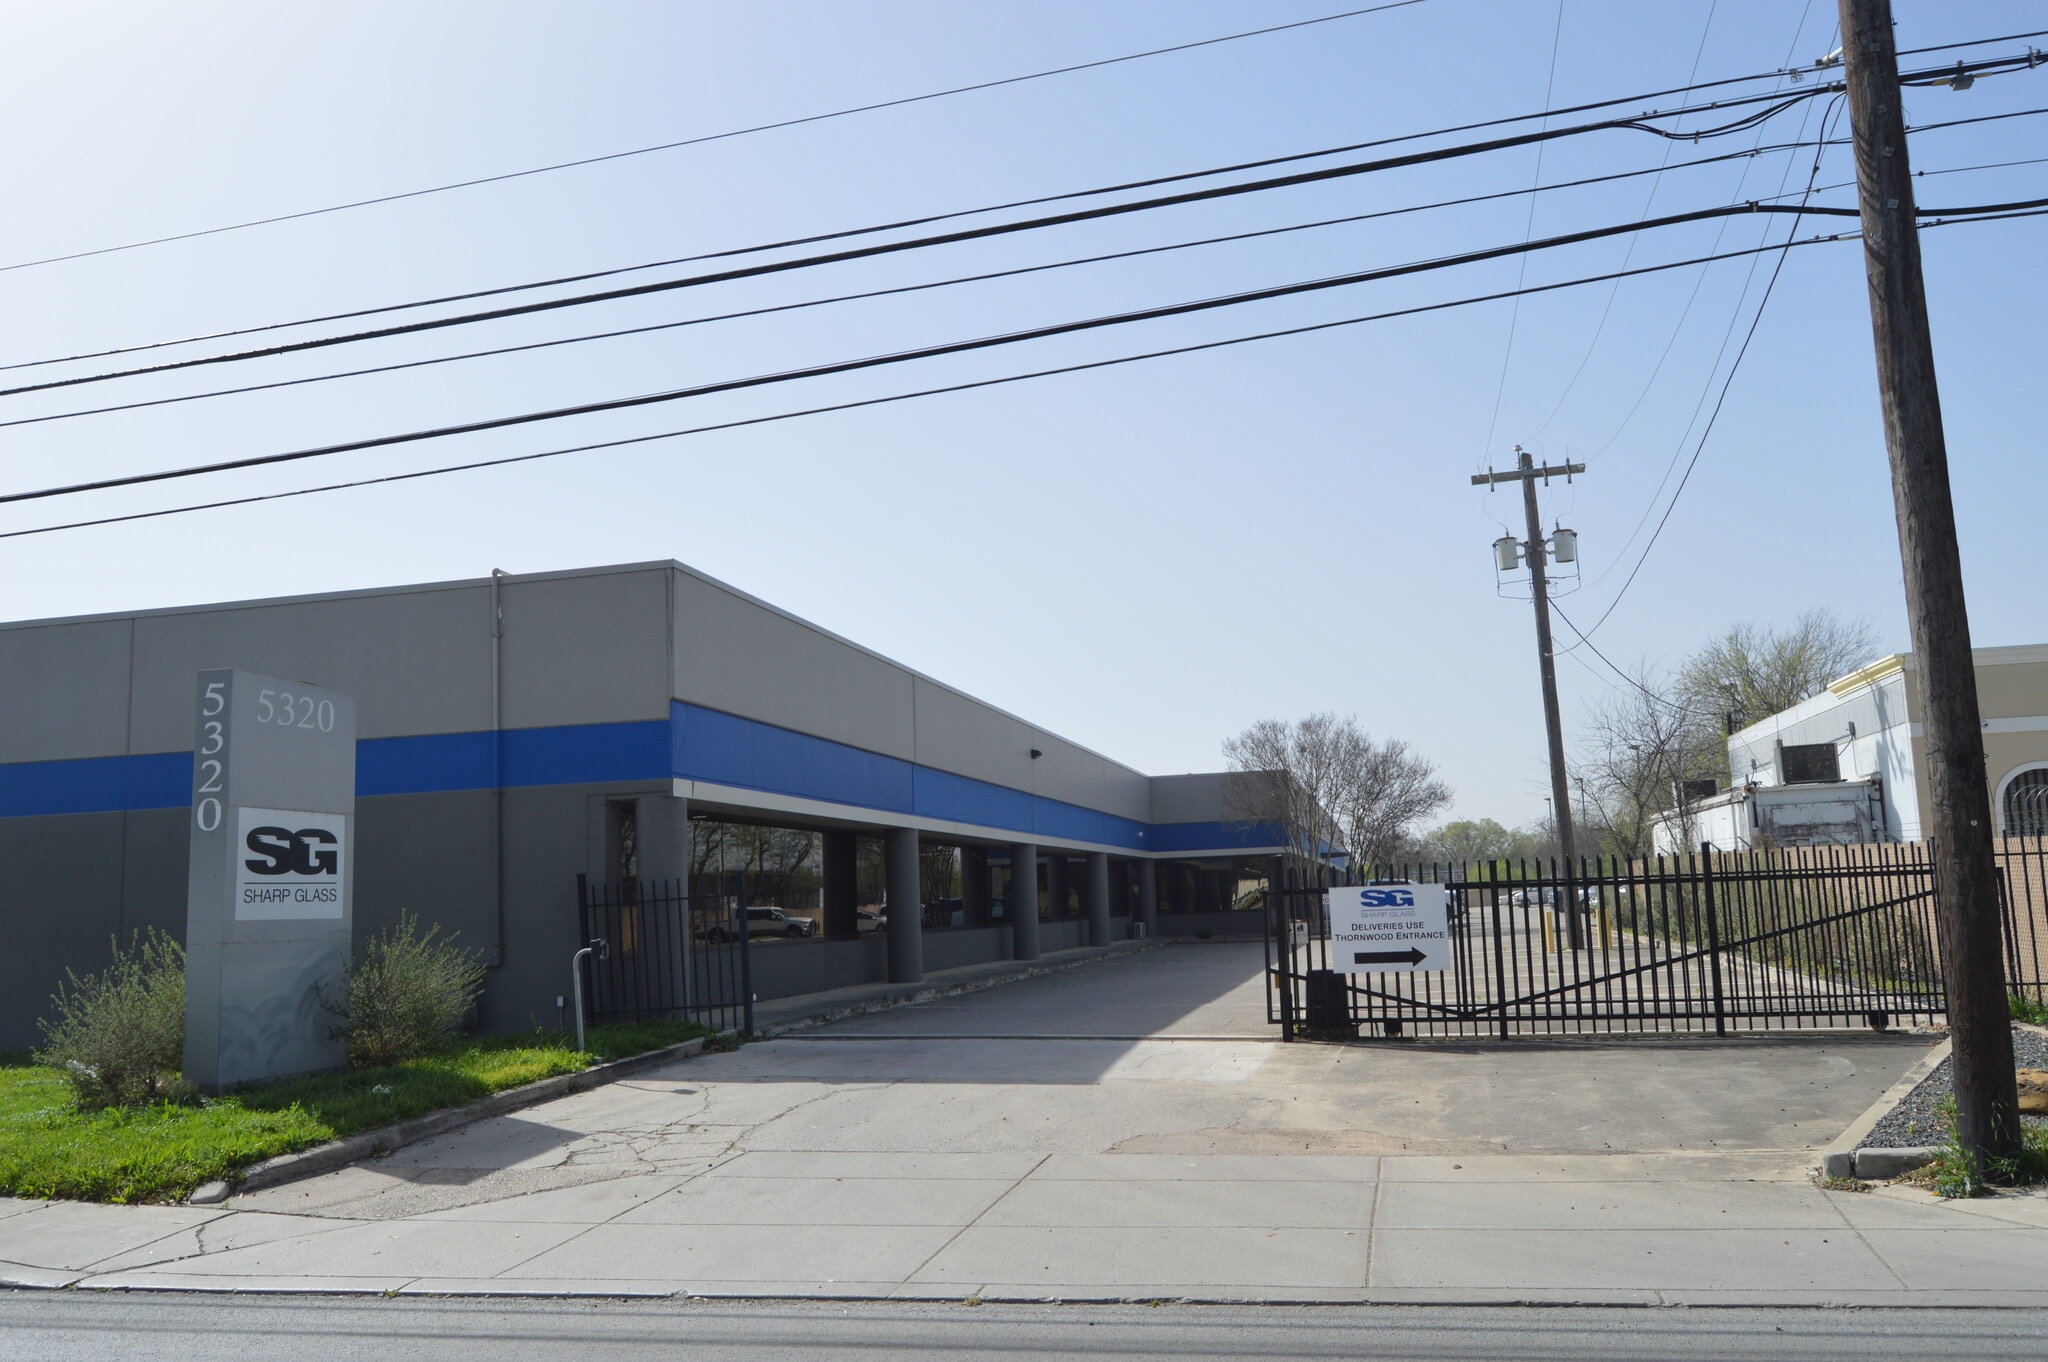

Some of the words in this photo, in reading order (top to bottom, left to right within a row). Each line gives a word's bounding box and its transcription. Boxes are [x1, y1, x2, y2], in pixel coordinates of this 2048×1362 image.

[256, 689, 335, 733] 5320
[197, 683, 225, 831] 5320
[243, 888, 291, 904] SHARP
[294, 888, 338, 903] GLASS
[1361, 911, 1388, 919] SHARP
[1389, 910, 1416, 918] GLASS
[1351, 922, 1403, 931] DELIVERIES
[1405, 921, 1425, 930] USE
[1335, 933, 1394, 942] THORNWOOD
[1396, 931, 1445, 940] ENTRANCE
